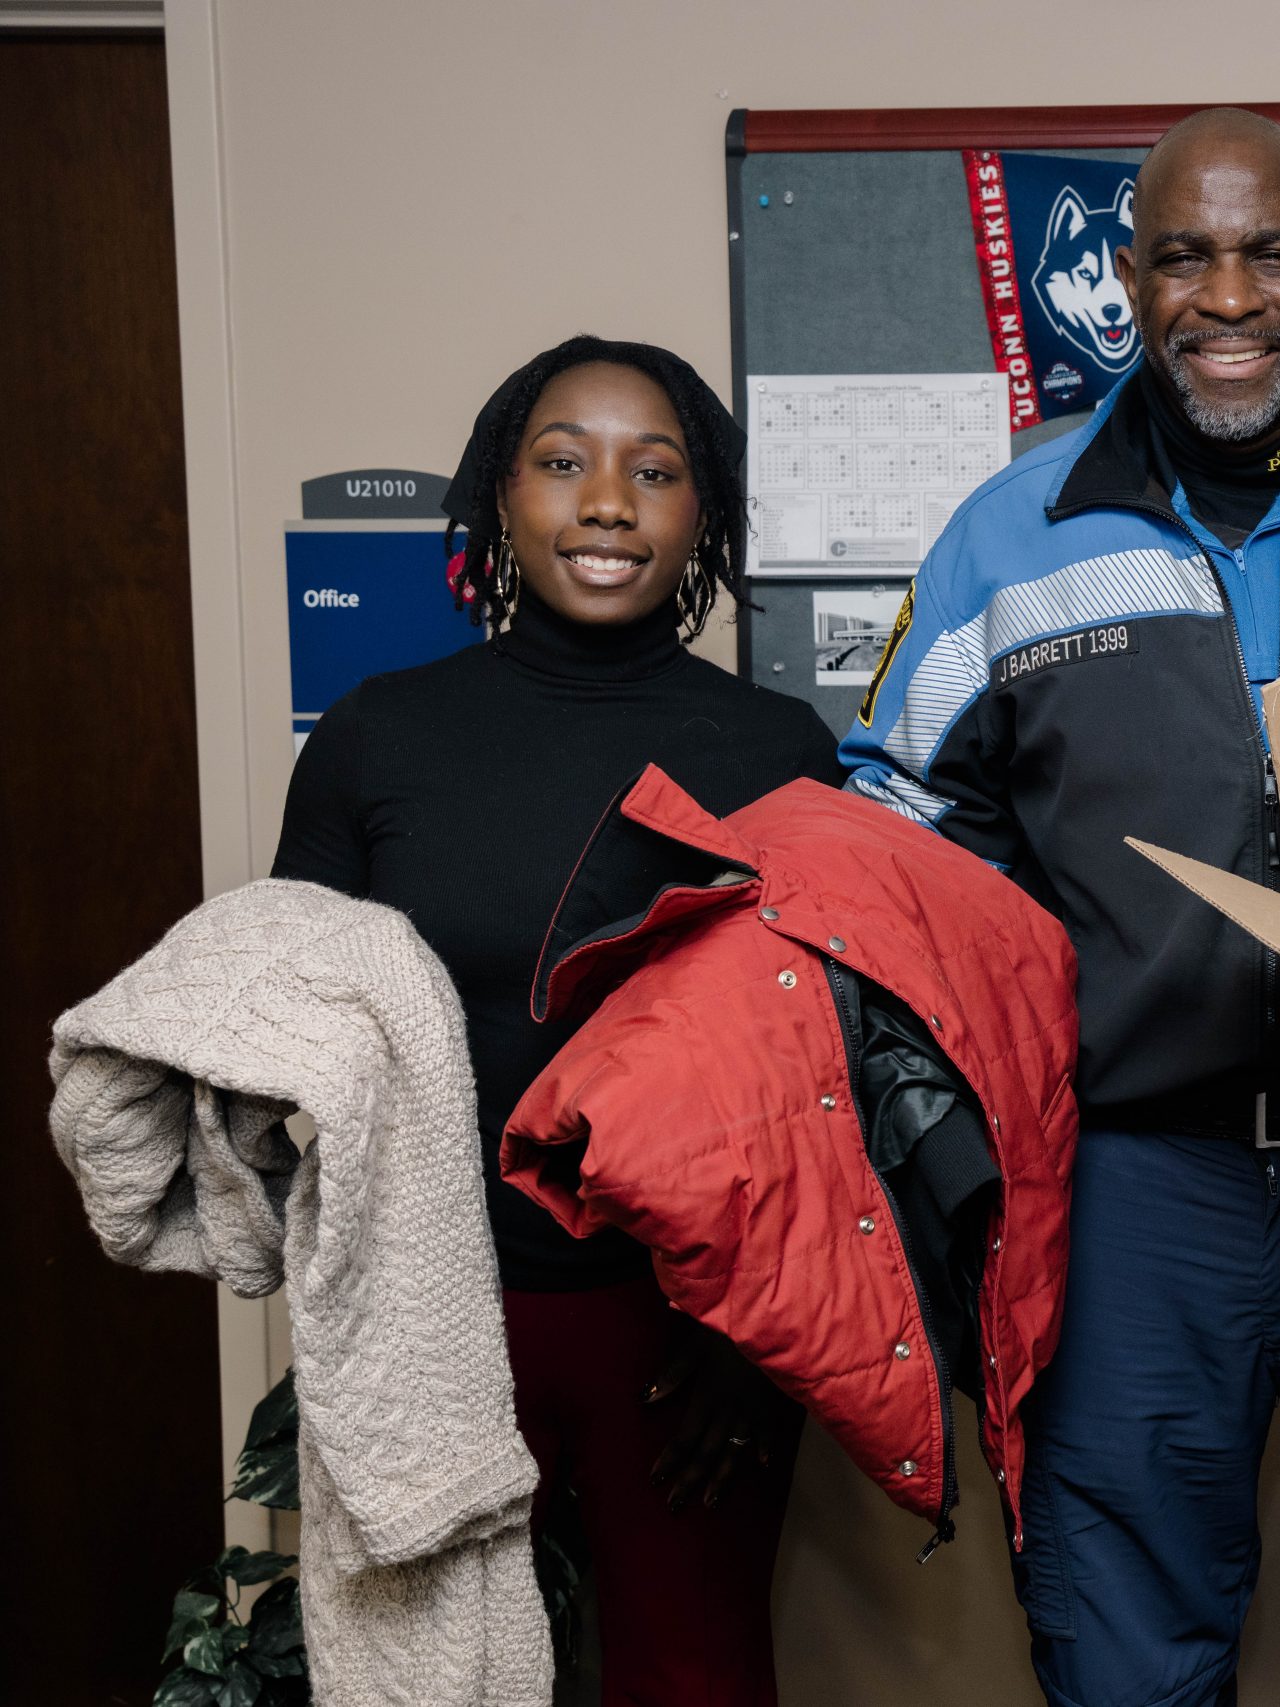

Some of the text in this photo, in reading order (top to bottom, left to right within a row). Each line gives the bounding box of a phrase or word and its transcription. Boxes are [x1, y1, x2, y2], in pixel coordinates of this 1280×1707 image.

[978, 164, 1035, 418] UCONN HUSKIES
[346, 480, 416, 498] U21010
[304, 588, 360, 608] Office
[1000, 626, 1128, 682] J BARRETT 1399
